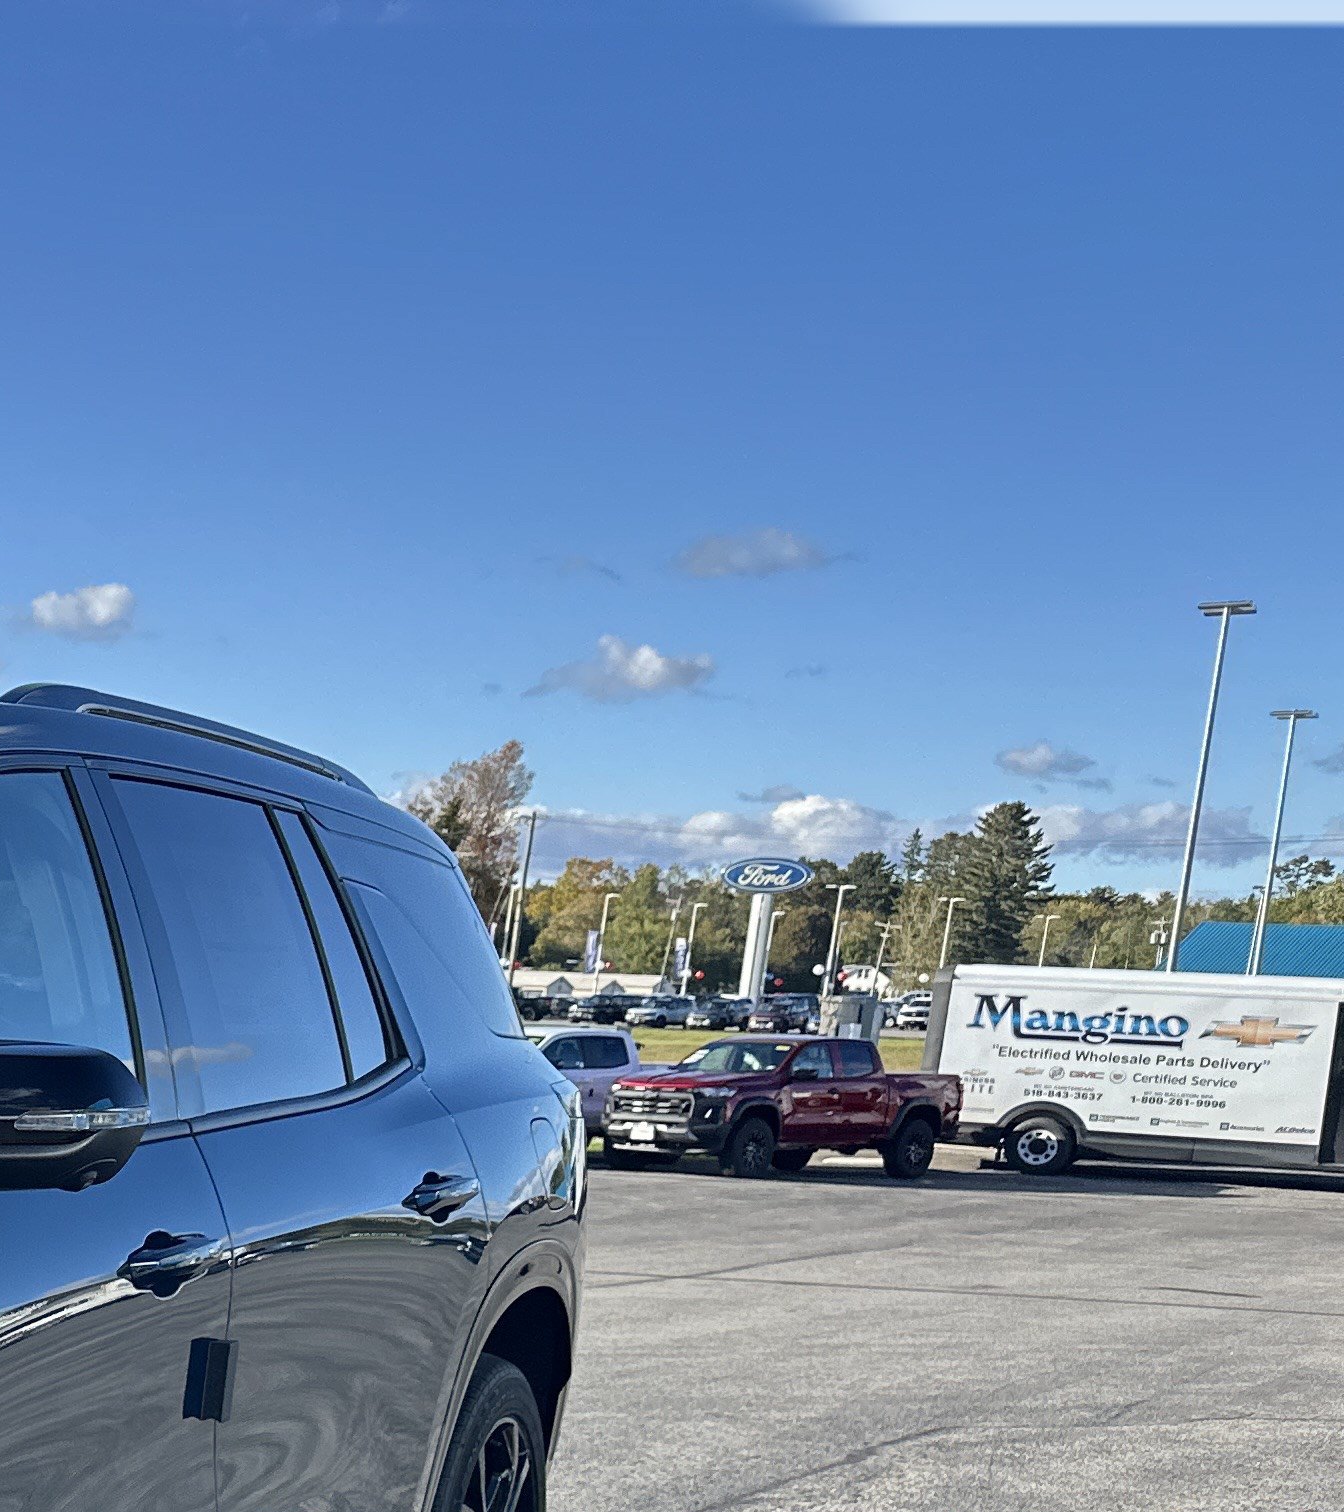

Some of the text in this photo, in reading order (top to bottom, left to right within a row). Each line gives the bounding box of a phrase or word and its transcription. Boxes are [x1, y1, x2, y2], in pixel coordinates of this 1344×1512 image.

[738, 863, 793, 886] Ford
[966, 993, 1189, 1045] Mangino
[1075, 1049, 1151, 1066] Wholesale
[1156, 1054, 1195, 1068] Parts
[1068, 1070, 1105, 1081] GMC
[1132, 1072, 1238, 1089] Certified Service
